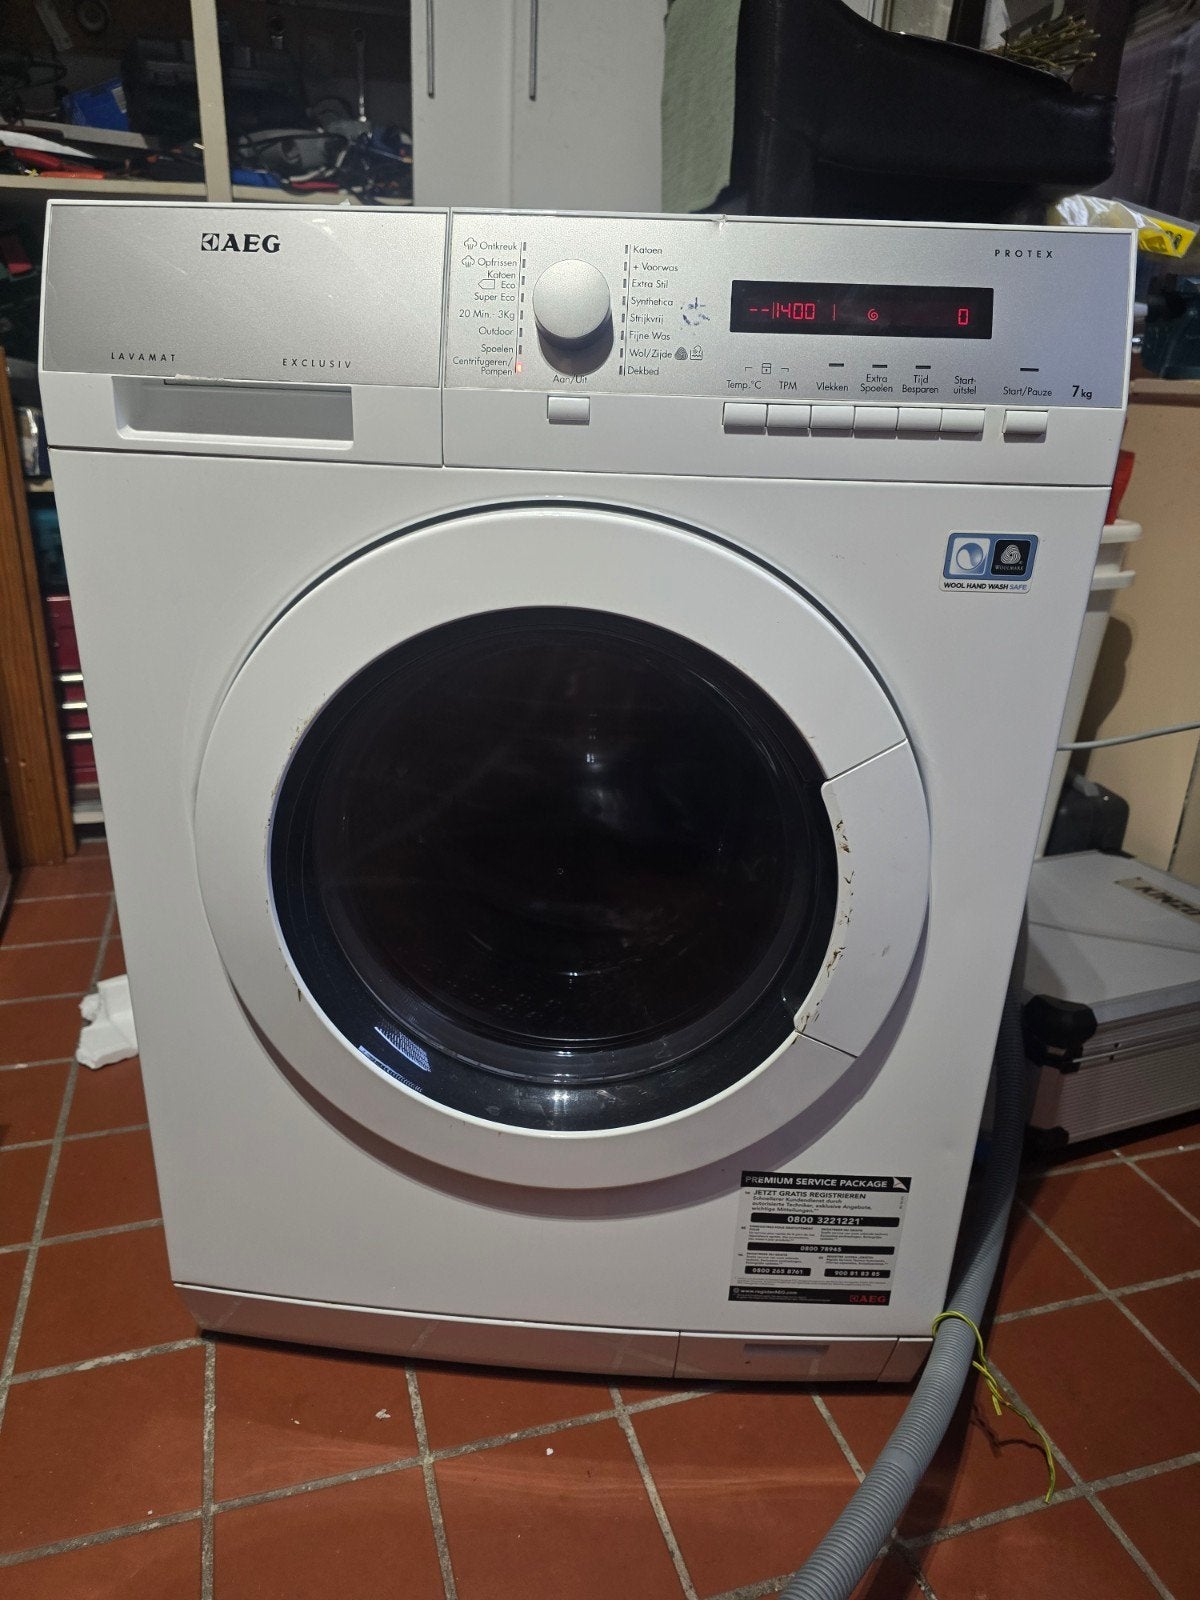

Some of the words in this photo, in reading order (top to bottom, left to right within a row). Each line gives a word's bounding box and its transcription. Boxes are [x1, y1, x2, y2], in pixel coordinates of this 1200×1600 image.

[220, 233, 281, 253] AEG
[480, 241, 518, 251] Ontkreuk
[633, 245, 663, 254] Katoen
[994, 249, 1053, 259] PROTEX
[477, 257, 518, 268] Opfrissen
[641, 262, 679, 272] Voorwas
[487, 270, 516, 279] Katoen
[501, 280, 516, 289] Eco
[631, 279, 653, 288] Extra
[656, 279, 669, 289] Stil
[474, 291, 498, 303] Super
[500, 292, 516, 302] Eco
[630, 296, 674, 307] Synthetica
[459, 308, 471, 318] 20
[498, 309, 515, 321] 3Kg
[629, 313, 664, 325] Strijkvrij
[478, 326, 514, 336] Outdoor
[629, 330, 650, 342] Fijne
[652, 331, 671, 341] Was
[480, 343, 514, 355] Spoelen
[629, 348, 673, 360] Wol/Zijde
[110, 352, 176, 363] LAVAMAT
[452, 356, 514, 368] Centrifugeren/
[282, 358, 352, 369] EXCLUSIV
[481, 367, 513, 378] Pompen
[627, 365, 660, 376] Dekbed
[552, 373, 588, 384] Aan/Uit
[866, 373, 888, 383] Extra
[913, 375, 929, 386] Tijd
[779, 380, 798, 390] TPM
[815, 381, 850, 392] Vlekken
[859, 383, 894, 393] Spoelen
[901, 385, 939, 395] Besparen
[953, 385, 977, 395] uitstel
[1002, 385, 1053, 397] Start/Pauze
[745, 1175, 794, 1185] PREMIUM
[795, 1178, 837, 1186] SERVICE
[839, 1179, 888, 1188] PACKAGE
[809, 1191, 867, 1199] REGISTRIEREN
[787, 1215, 814, 1224] 0800
[860, 1295, 886, 1304] AEG
